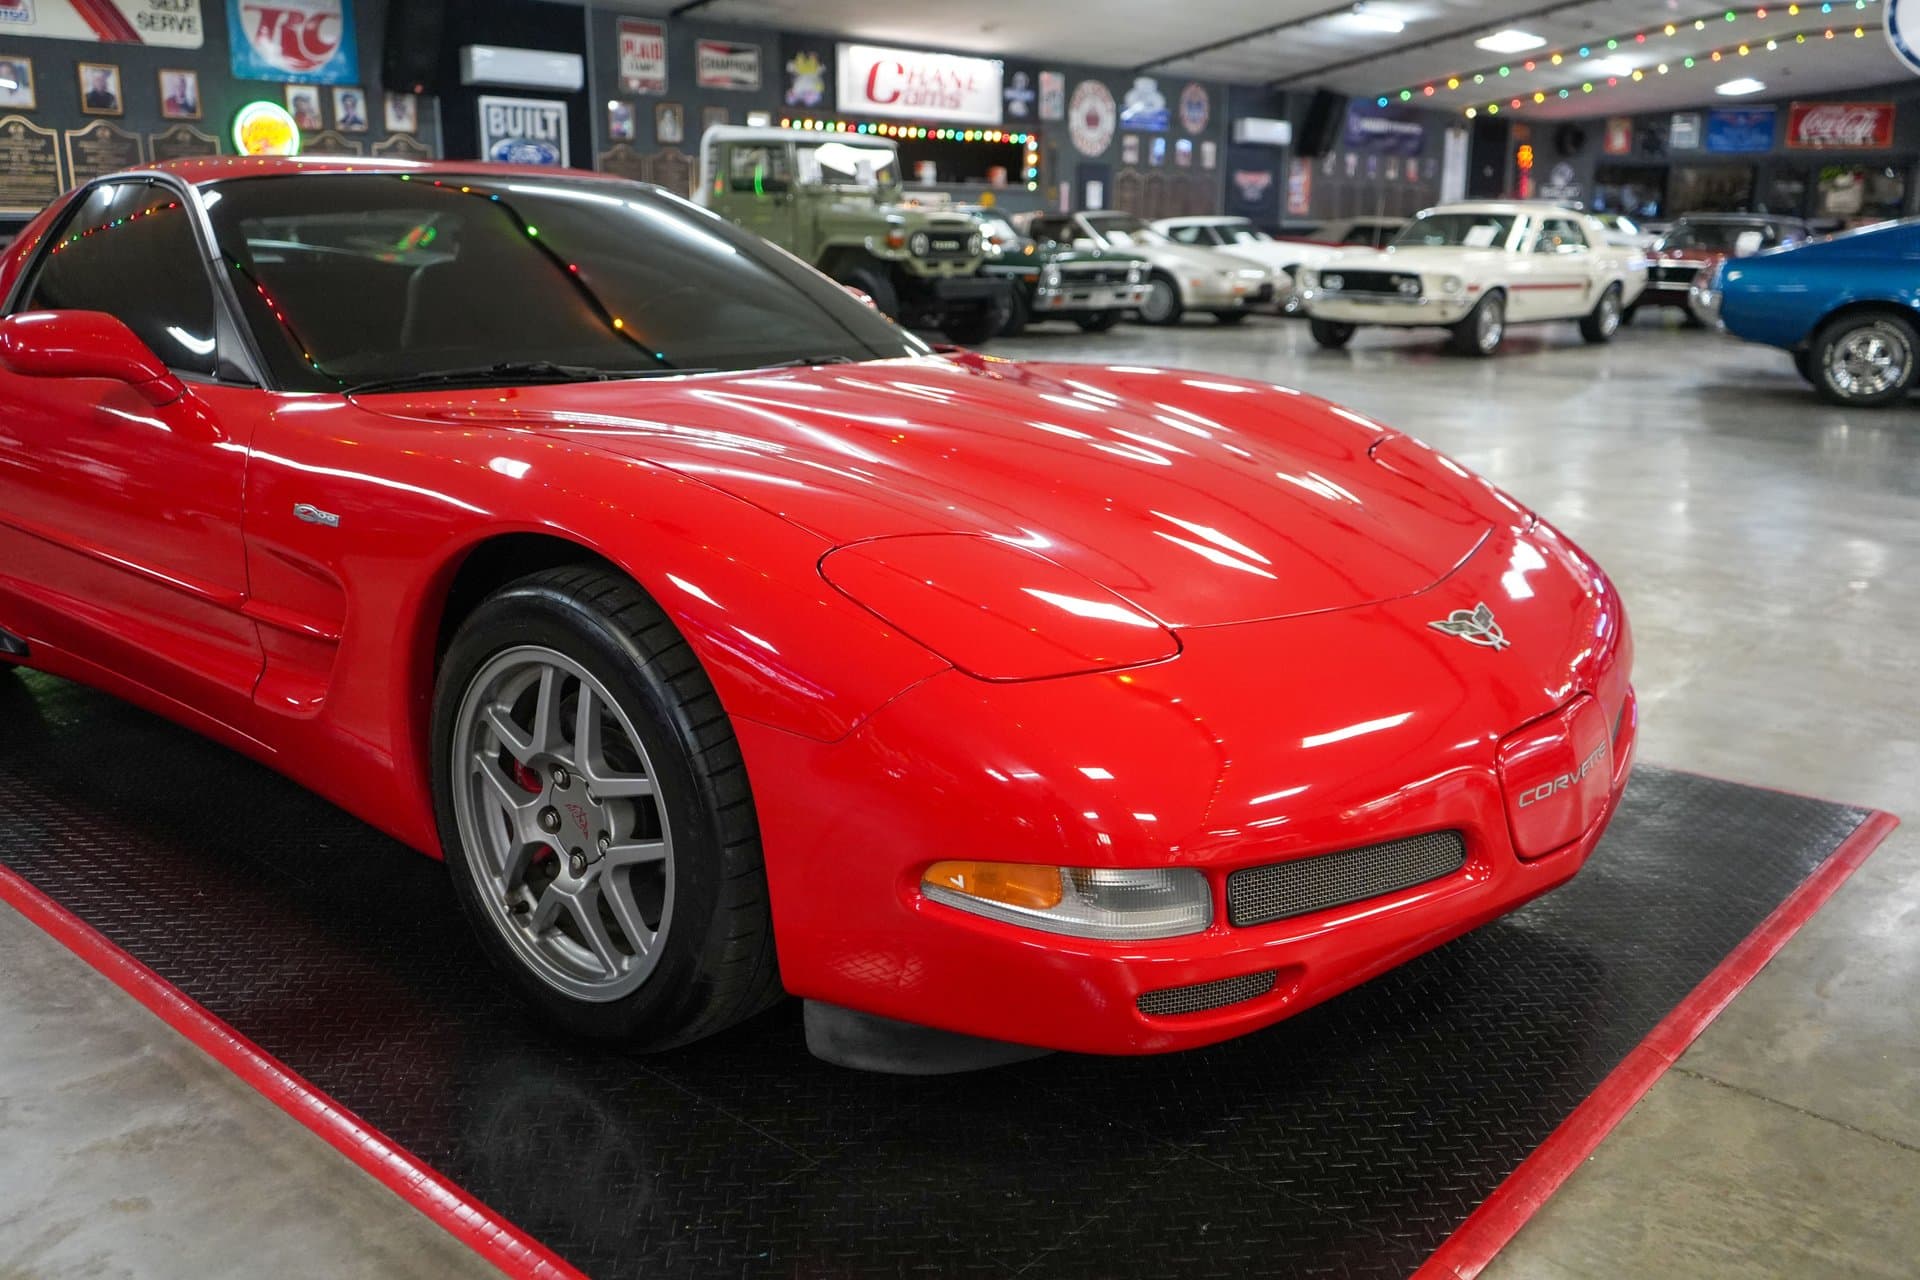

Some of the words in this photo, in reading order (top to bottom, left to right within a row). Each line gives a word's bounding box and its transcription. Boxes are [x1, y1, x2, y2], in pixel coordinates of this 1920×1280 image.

[136, 12, 198, 34] SERVE
[701, 56, 757, 72] CHAMPION
[488, 106, 559, 139] BUILT
[1519, 741, 1606, 807] CORVETTE
